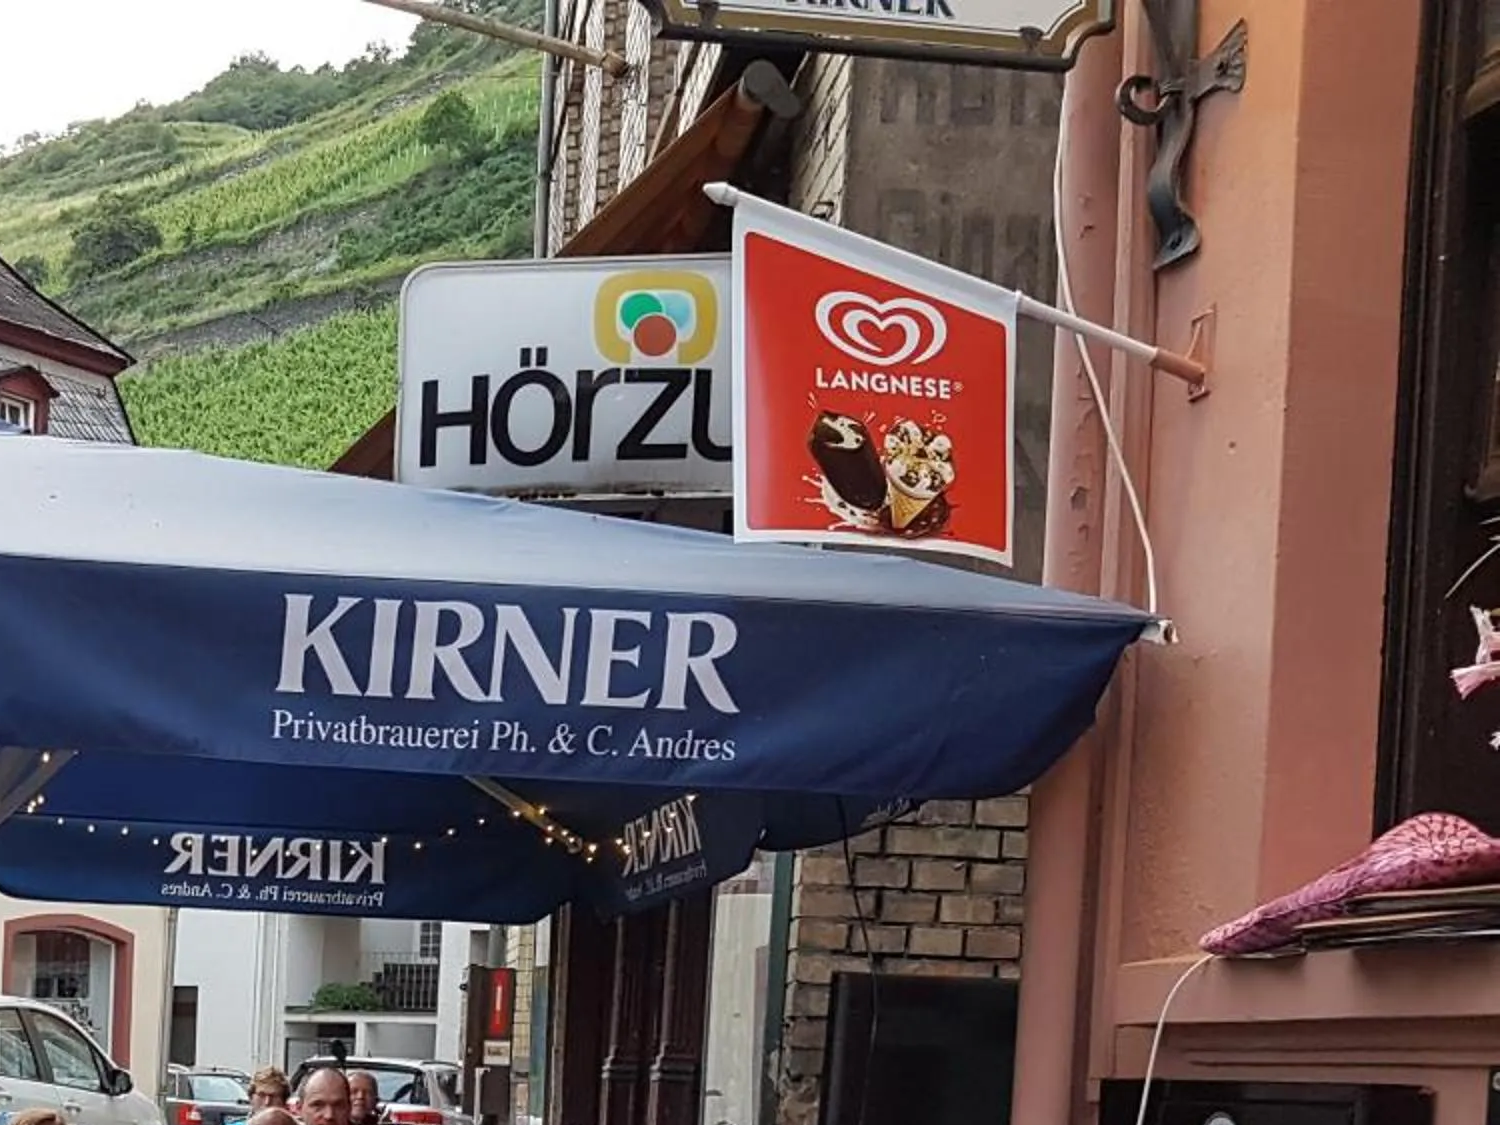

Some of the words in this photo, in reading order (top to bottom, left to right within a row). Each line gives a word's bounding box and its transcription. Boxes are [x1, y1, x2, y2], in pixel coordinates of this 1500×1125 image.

[275, 593, 740, 713] KIRNER
[272, 709, 480, 750] Privatbrauerei
[490, 721, 536, 753] Ph.
[547, 723, 575, 754] &
[586, 725, 619, 756] C.
[628, 729, 736, 761] Andres
